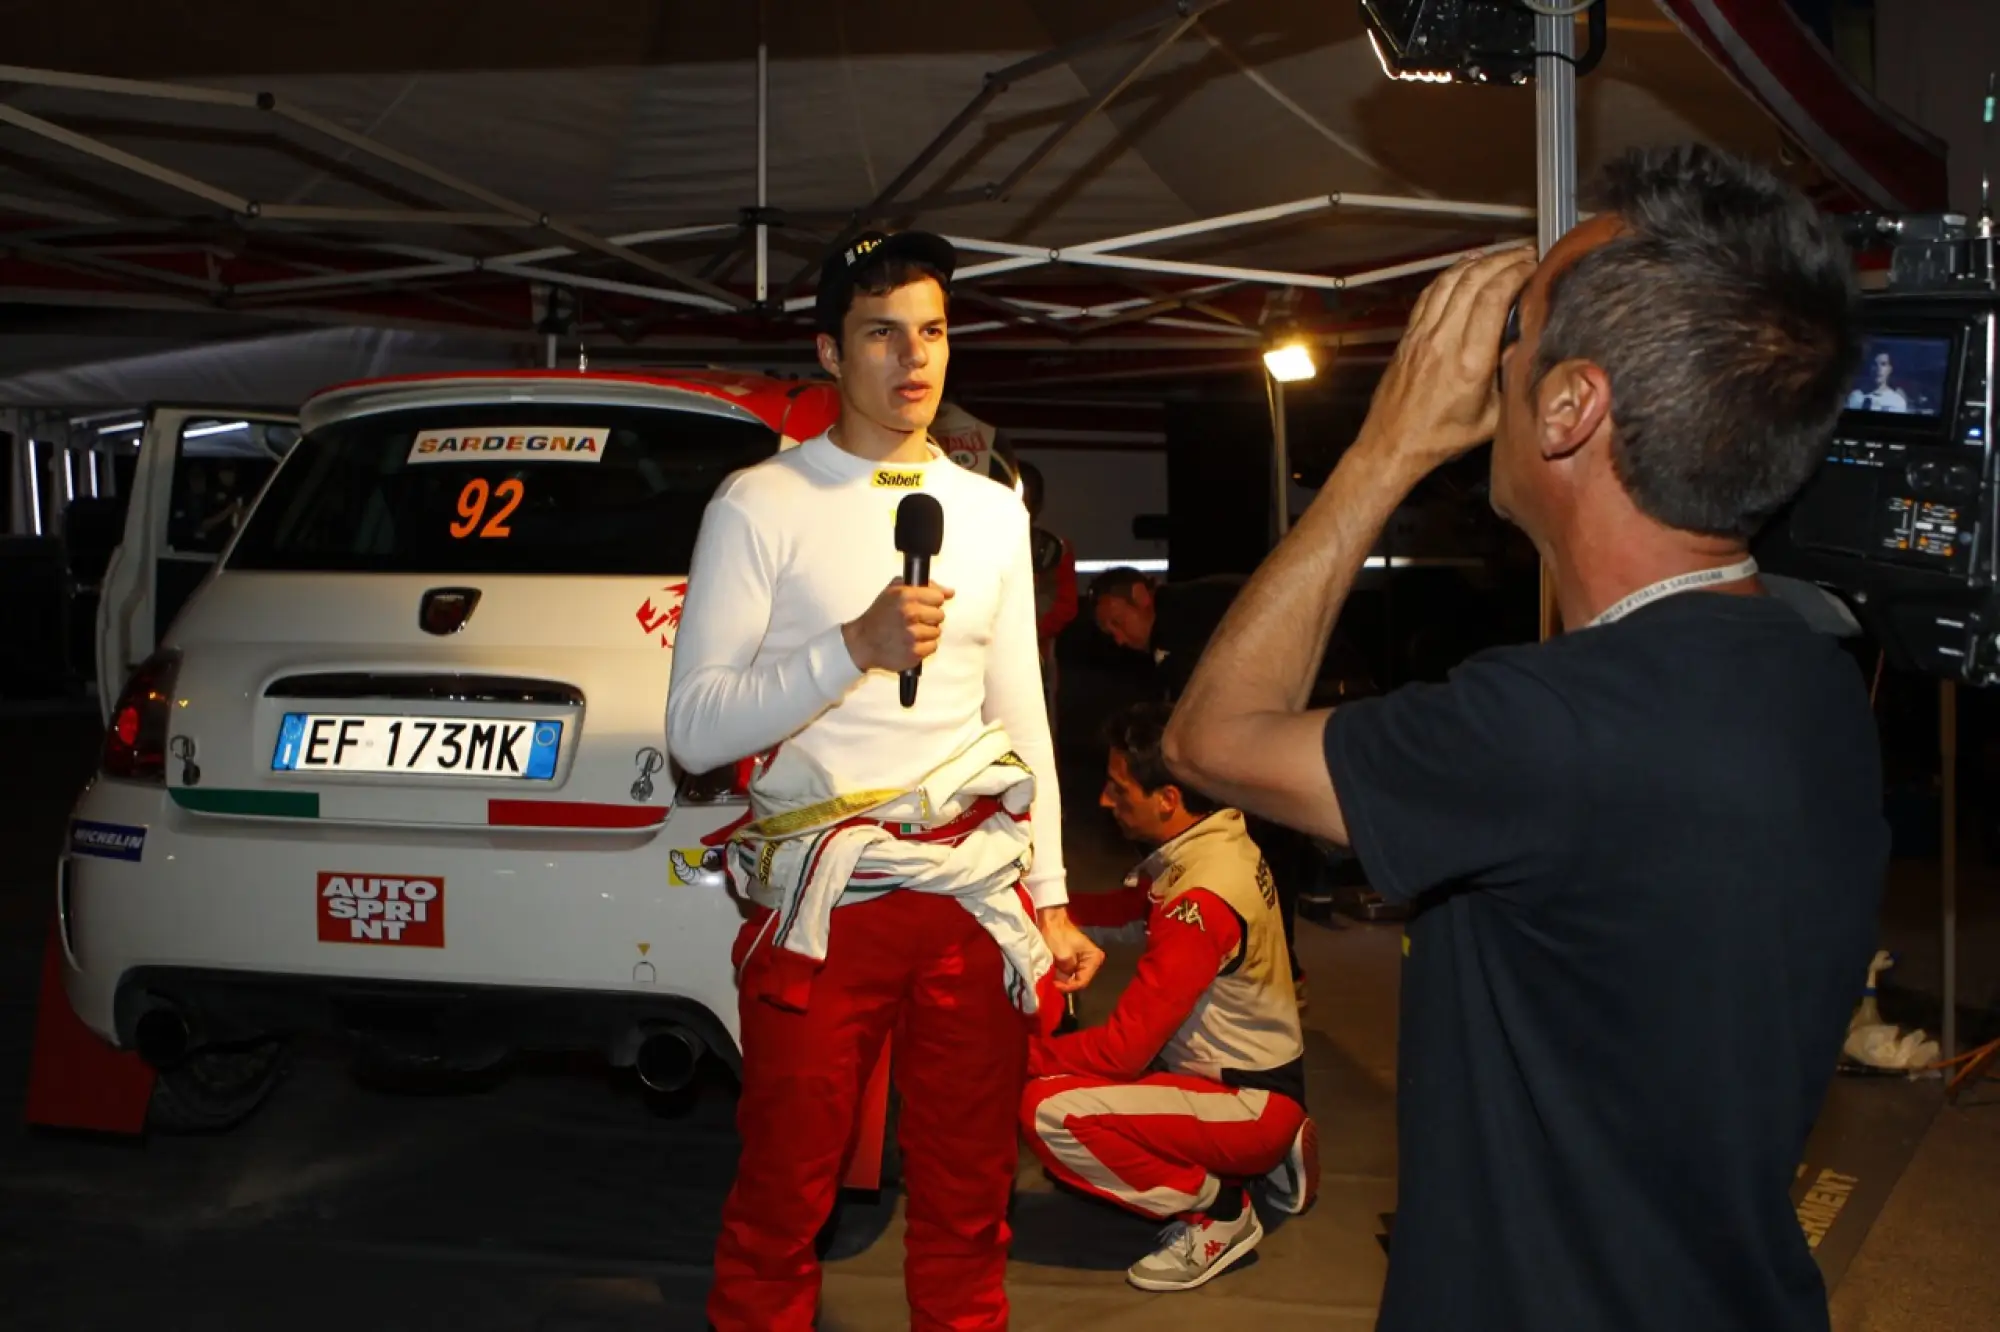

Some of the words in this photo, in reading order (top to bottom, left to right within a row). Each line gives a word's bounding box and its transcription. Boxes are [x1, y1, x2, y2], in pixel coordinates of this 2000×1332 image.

[418, 435, 598, 454] SARDEGNA
[876, 471, 922, 487] Sabelt
[450, 477, 525, 539] 92
[304, 719, 364, 765] EF
[385, 721, 526, 773] 173MK
[322, 876, 438, 901] AUTO
[328, 897, 427, 922] SPRI
[350, 919, 407, 940] NT
